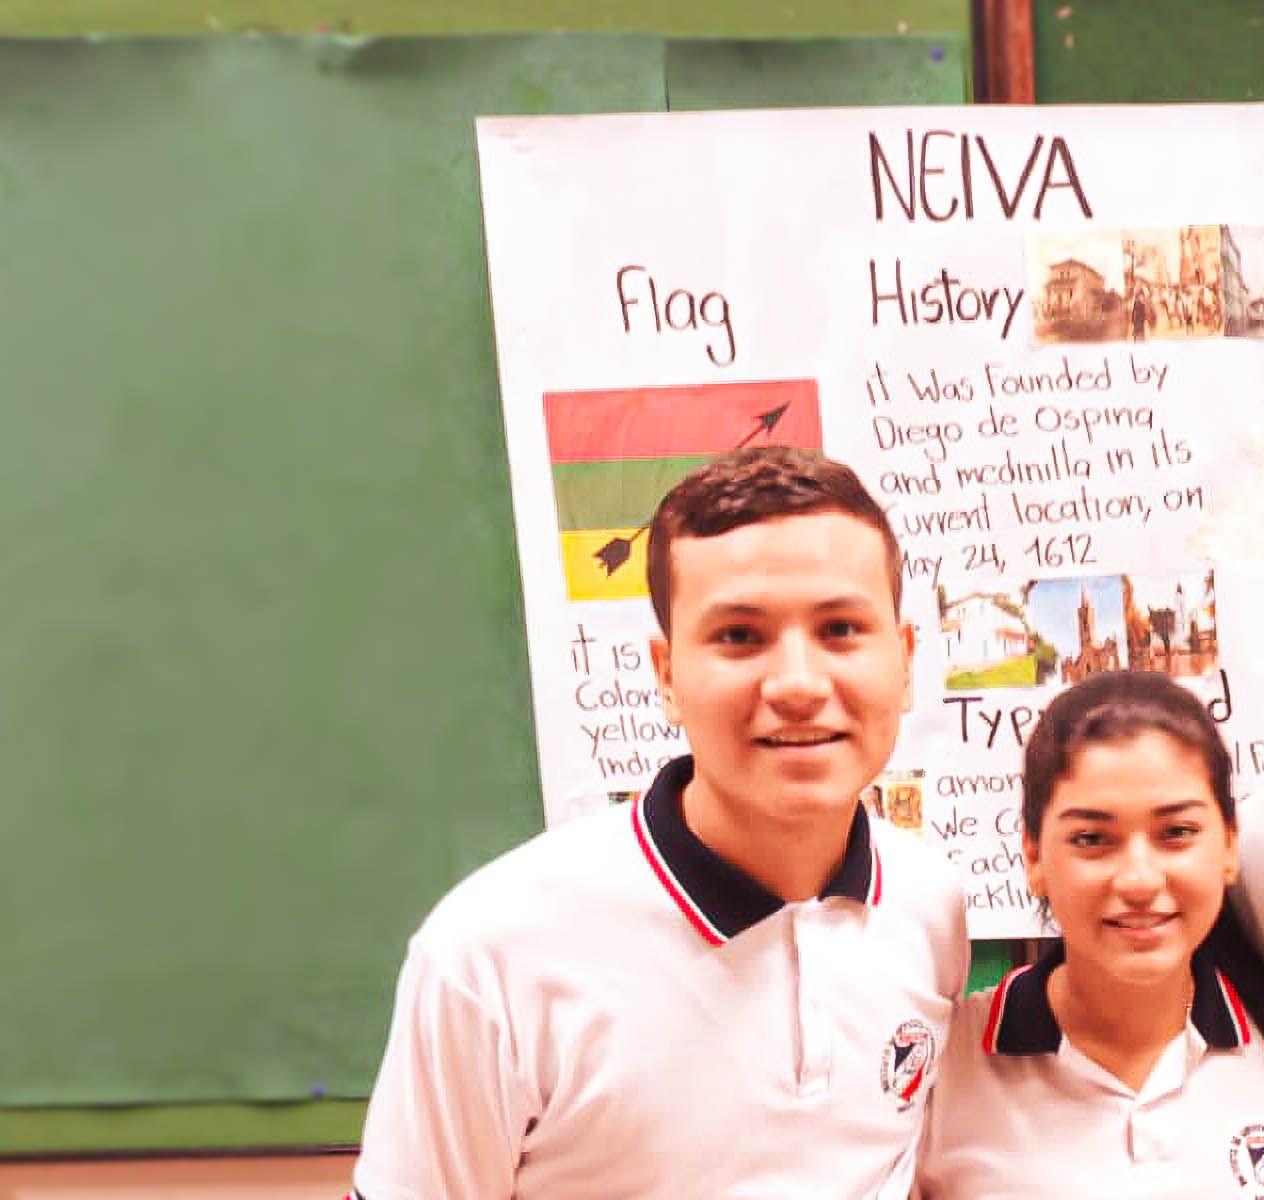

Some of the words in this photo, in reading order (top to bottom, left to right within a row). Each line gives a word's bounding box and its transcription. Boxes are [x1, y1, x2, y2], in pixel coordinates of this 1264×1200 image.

[869, 128, 1093, 222] NEIVA
[869, 257, 1024, 339] History
[1131, 352, 1169, 391] by
[873, 416, 963, 463] Diego
[978, 404, 1018, 436] de
[880, 463, 942, 495] and
[1107, 449, 1134, 474] in
[1152, 427, 1192, 469] its
[1012, 485, 1152, 528] location,
[1163, 486, 1203, 512] on
[1024, 534, 1097, 568] 1612
[937, 773, 1024, 798] amon
